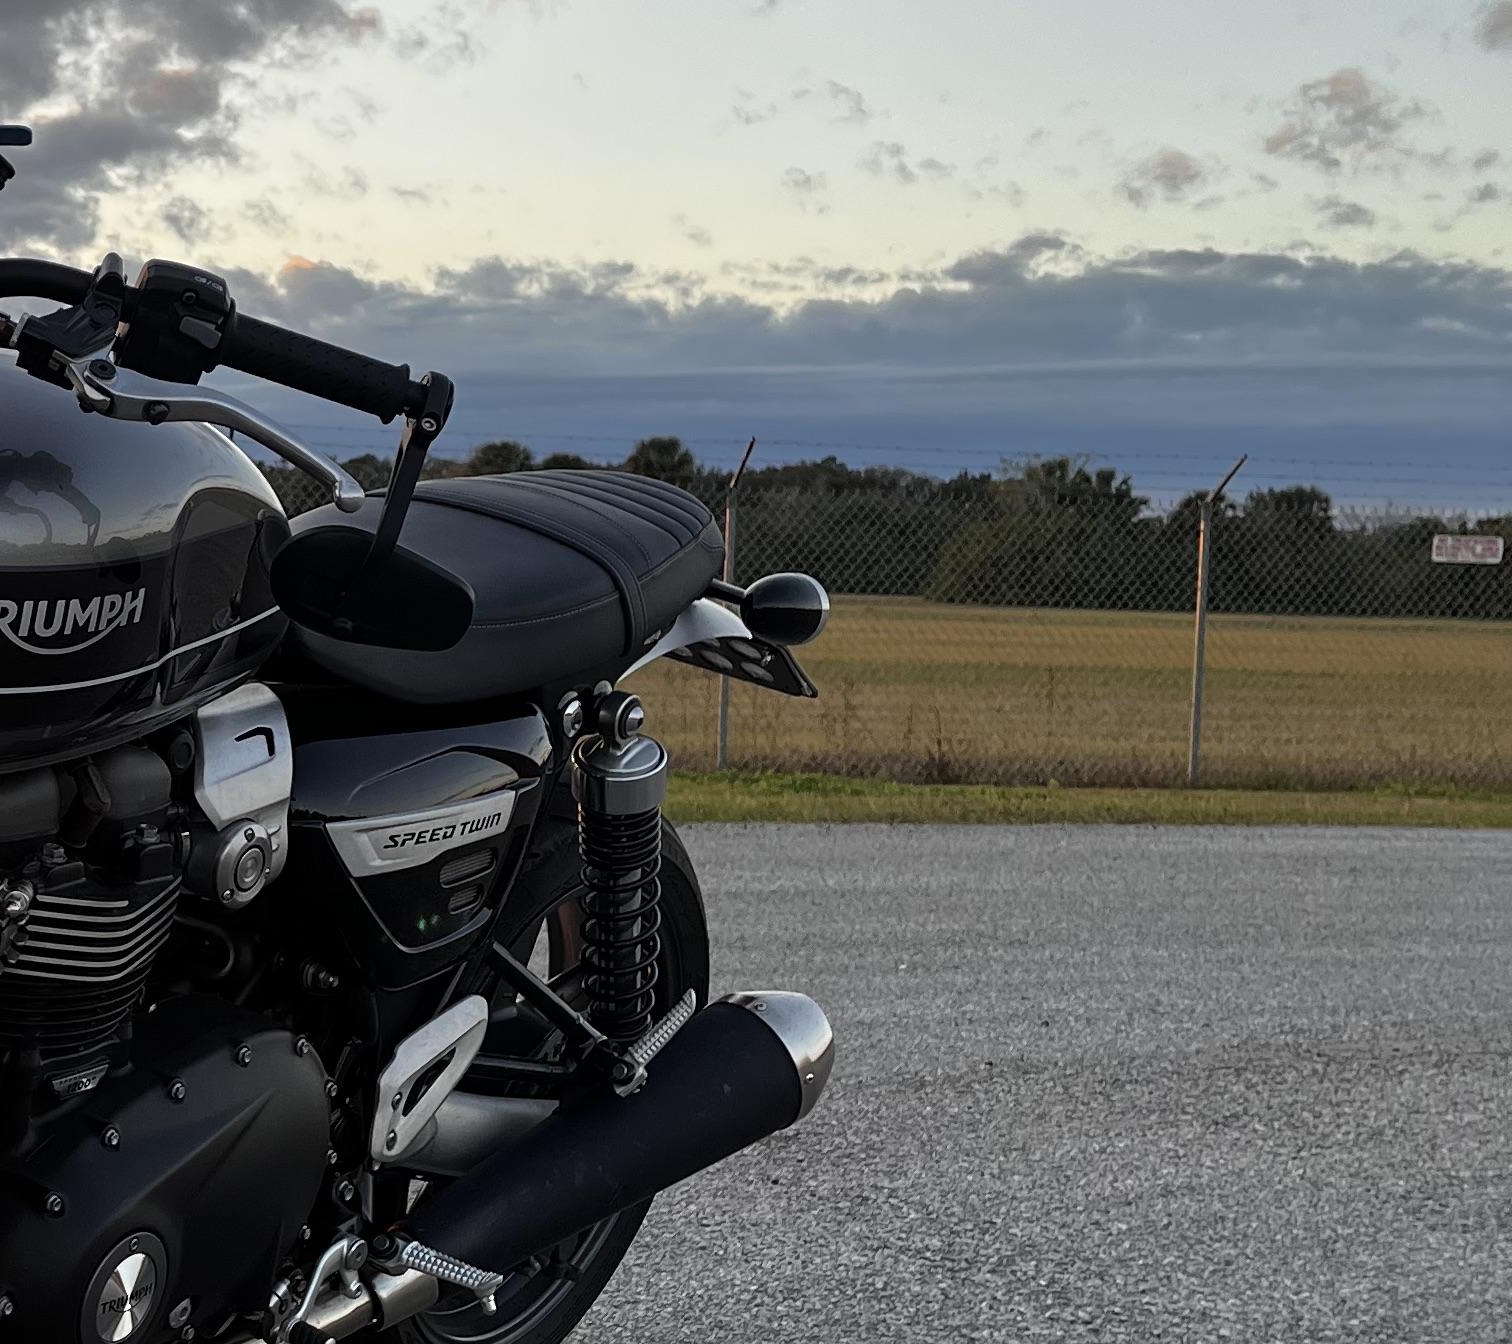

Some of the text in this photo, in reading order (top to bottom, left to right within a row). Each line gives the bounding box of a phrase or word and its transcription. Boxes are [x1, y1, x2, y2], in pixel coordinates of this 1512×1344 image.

[383, 812, 502, 849] SPEED TWIN
[100, 1283, 154, 1315] TRIUMPH
